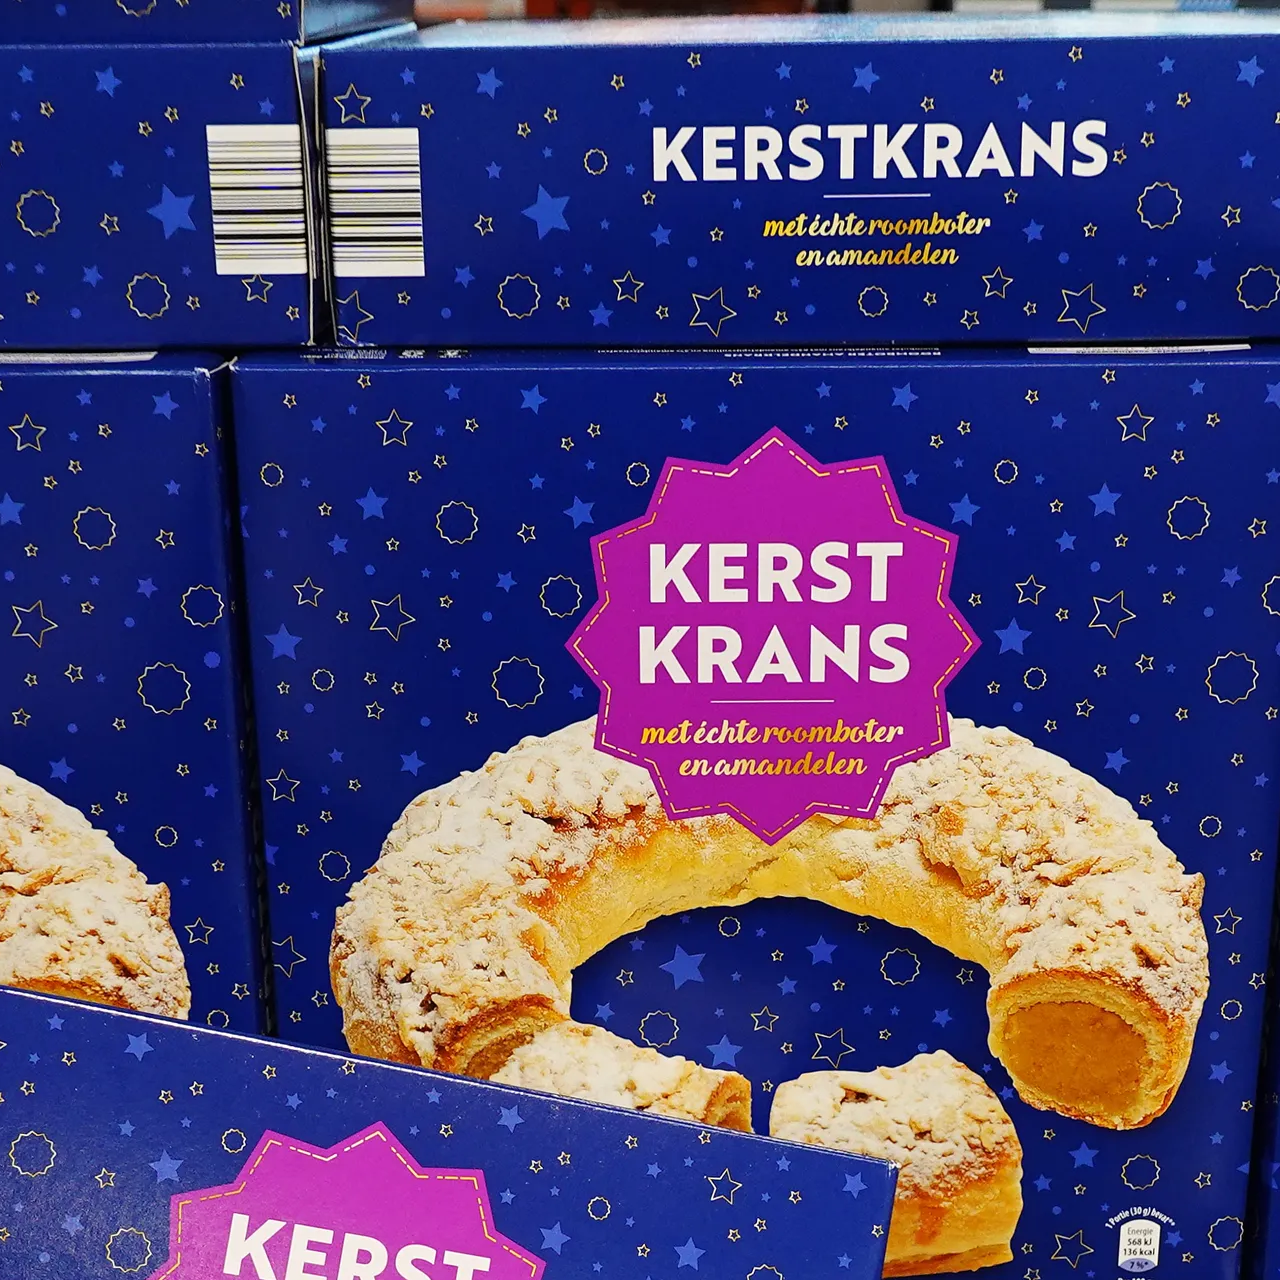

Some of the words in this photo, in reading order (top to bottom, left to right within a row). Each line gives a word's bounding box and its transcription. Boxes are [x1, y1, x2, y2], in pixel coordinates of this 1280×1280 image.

[652, 120, 1108, 181] KERSTKRANS
[763, 213, 808, 237] met
[867, 211, 990, 235] roomboter
[795, 248, 824, 267] en
[824, 242, 958, 265] amandelen
[649, 542, 903, 603] KERST
[638, 624, 911, 684] KRANS
[641, 719, 691, 744] met
[762, 719, 904, 743] roomboter
[679, 758, 714, 776] en
[714, 752, 867, 775] amandelen
[1127, 1227, 1153, 1236] Energie
